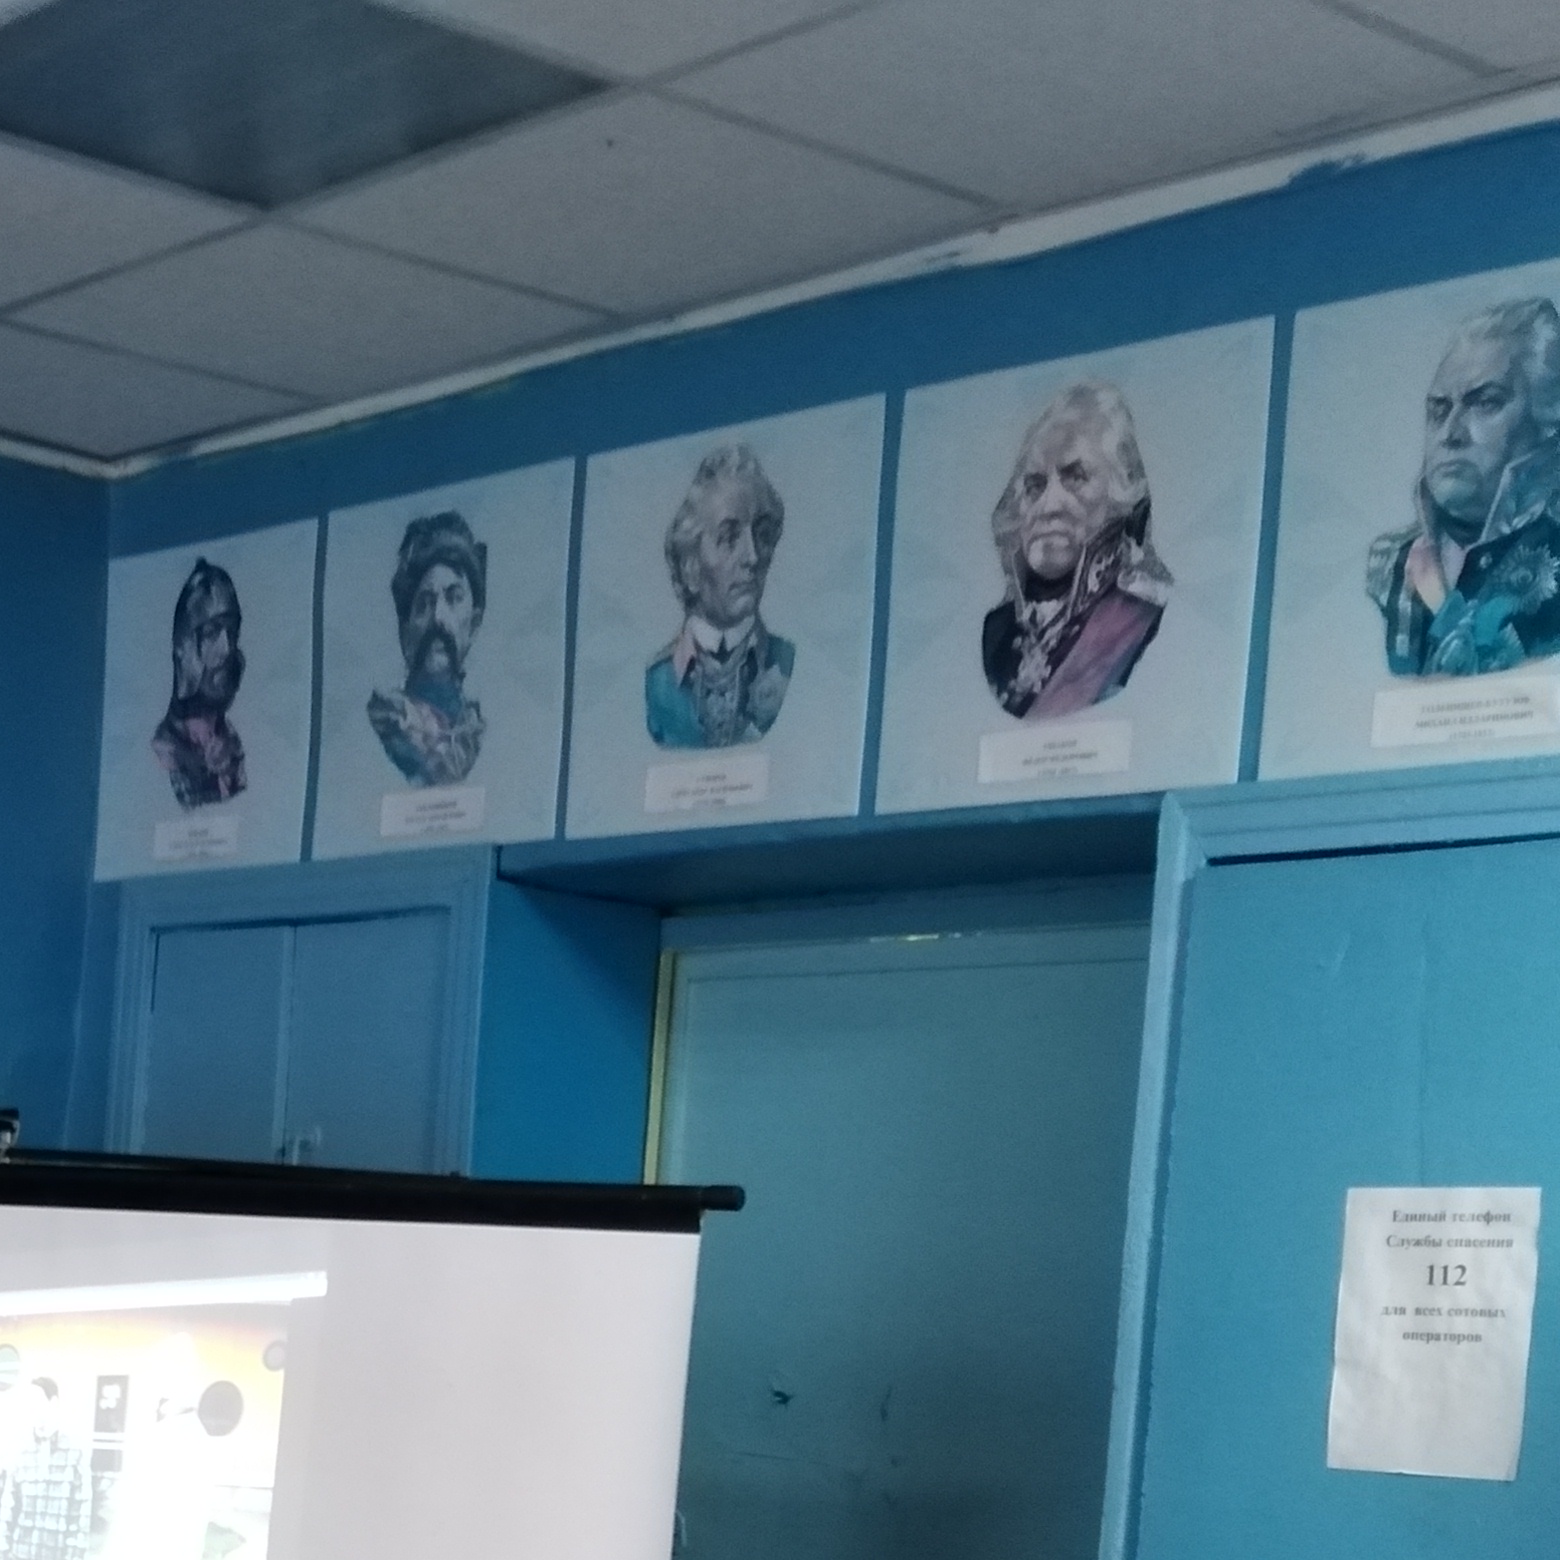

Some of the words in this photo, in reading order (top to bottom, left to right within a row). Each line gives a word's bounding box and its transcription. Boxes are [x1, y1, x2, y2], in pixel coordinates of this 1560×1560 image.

[1392, 1209, 1447, 1223] Единый
[1452, 1210, 1512, 1225] телефон
[1386, 1234, 1443, 1250] Службы
[1446, 1237, 1514, 1248] спасения
[1426, 1263, 1468, 1287] 112
[1381, 1306, 1407, 1316] для
[1414, 1306, 1443, 1317] всех
[1446, 1308, 1506, 1318] сотовых
[1402, 1331, 1483, 1345] операторов
